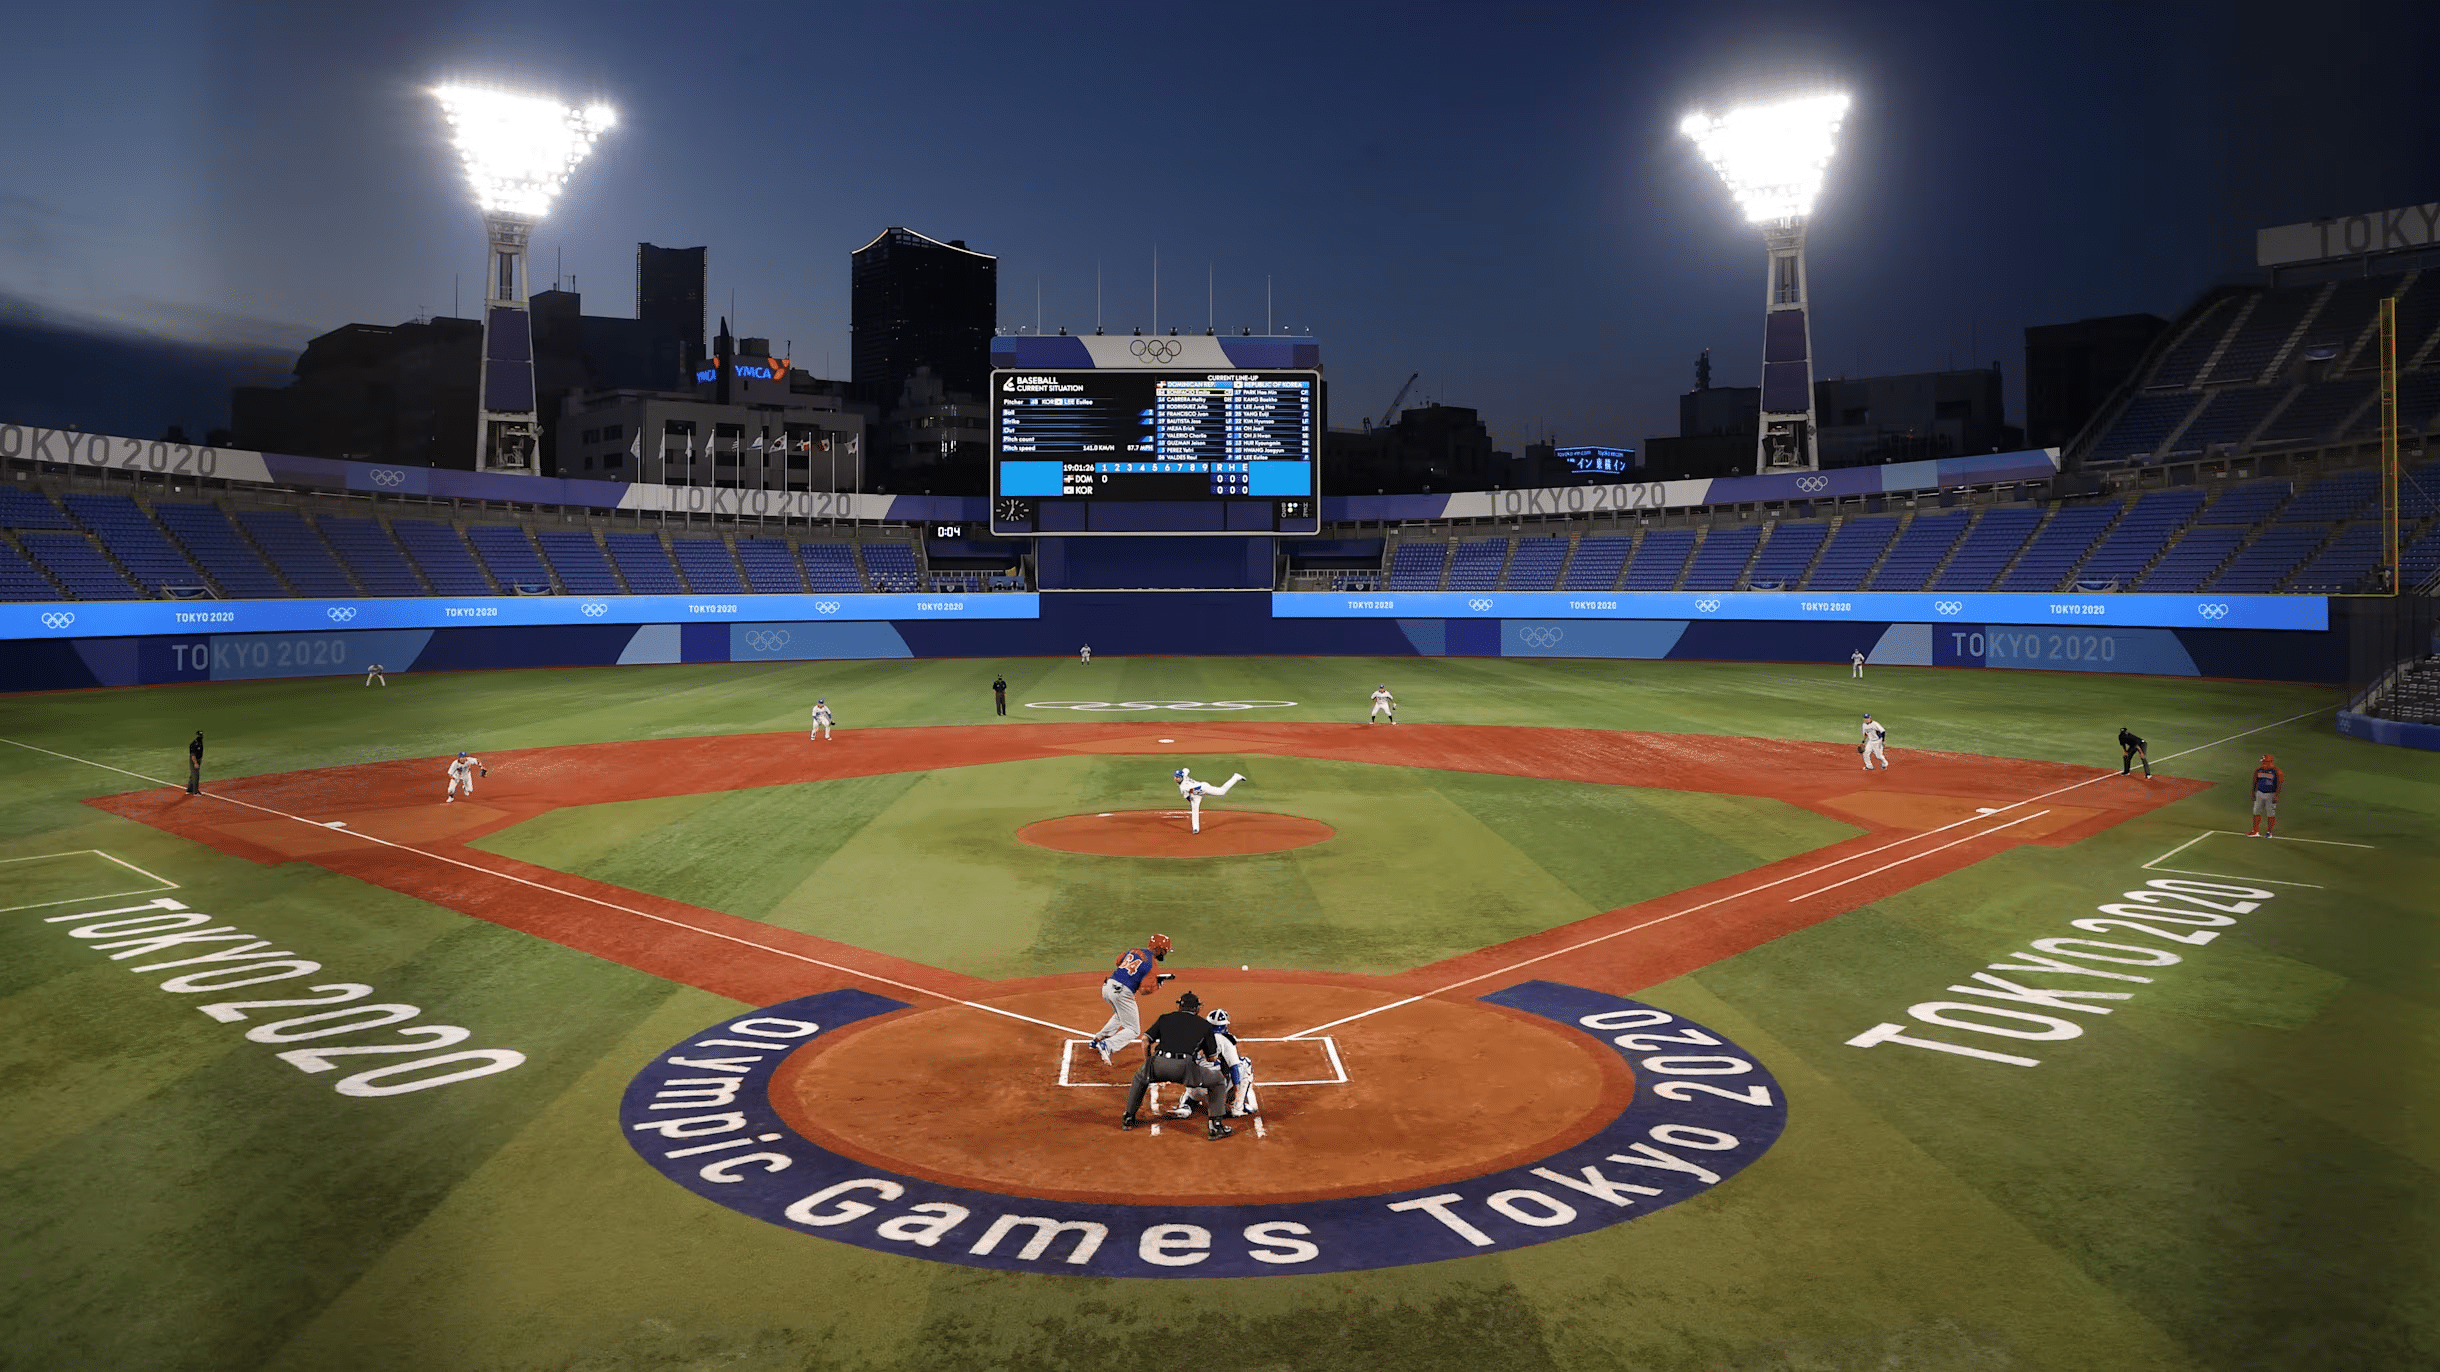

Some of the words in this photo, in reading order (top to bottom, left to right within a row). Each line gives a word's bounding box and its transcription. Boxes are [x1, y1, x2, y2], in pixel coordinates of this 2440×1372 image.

[735, 365, 772, 379] YMCA
[1016, 377, 1058, 385] BASEBALL
[122, 438, 217, 477] 2020
[1064, 464, 1095, 472] 19:01:26
[1102, 463, 1108, 472] 1
[1114, 463, 1120, 472] 2
[1127, 463, 1133, 472] 3
[1139, 463, 1145, 472] 4
[1152, 463, 1158, 472] 5
[1165, 463, 1171, 472] 6
[1178, 463, 1184, 472] 7
[1190, 463, 1196, 472] 8
[1202, 463, 1208, 472] 9
[1217, 463, 1223, 472] R
[1229, 463, 1236, 472] H
[1243, 463, 1248, 472] E
[1075, 475, 1093, 484] DOM
[1101, 475, 1108, 484] 0
[1217, 475, 1223, 484] 0
[1230, 475, 1236, 484] 0
[1242, 475, 1248, 484] 0
[1075, 486, 1093, 495] KOR
[1217, 486, 1223, 495] 0
[1230, 486, 1236, 495] 0
[1242, 486, 1248, 495] 0
[667, 485, 769, 515] TOKYO
[778, 492, 851, 518] 2020
[1486, 486, 1585, 517] TOKYO
[1593, 482, 1667, 512] 2020
[937, 526, 961, 538] 0:04
[689, 605, 715, 613] TOKYO
[717, 605, 738, 613] 2020
[917, 603, 942, 611] TOKYO
[943, 603, 964, 611] 2020
[1348, 601, 1373, 609] TOKYO
[1374, 601, 1394, 609] 2020
[1570, 601, 1596, 609] TOKYO
[1597, 601, 1617, 609] 2020
[1801, 602, 1829, 611] TOKYO
[1830, 602, 1851, 611] 2020
[2050, 604, 2080, 615] TOKYO
[2081, 604, 2105, 615] 2020
[175, 612, 208, 623] TOKYO
[210, 612, 234, 623] 2020
[445, 607, 475, 617] TOKYO
[476, 607, 498, 617] 2020
[1951, 632, 2041, 659] TOKYO
[2049, 635, 2116, 661] 2020
[172, 641, 269, 671] TOKYO
[277, 639, 345, 667] 2020
[1844, 937, 2183, 1067] TOKYO
[2071, 879, 2274, 945] 2020
[44, 898, 322, 993] TOKYO
[197, 983, 526, 1097] 2020
[634, 1016, 819, 1184] Olympic
[784, 1178, 1319, 1265] Games
[1387, 1123, 1740, 1247] Tokyo
[1579, 1009, 1773, 1107] 2020
